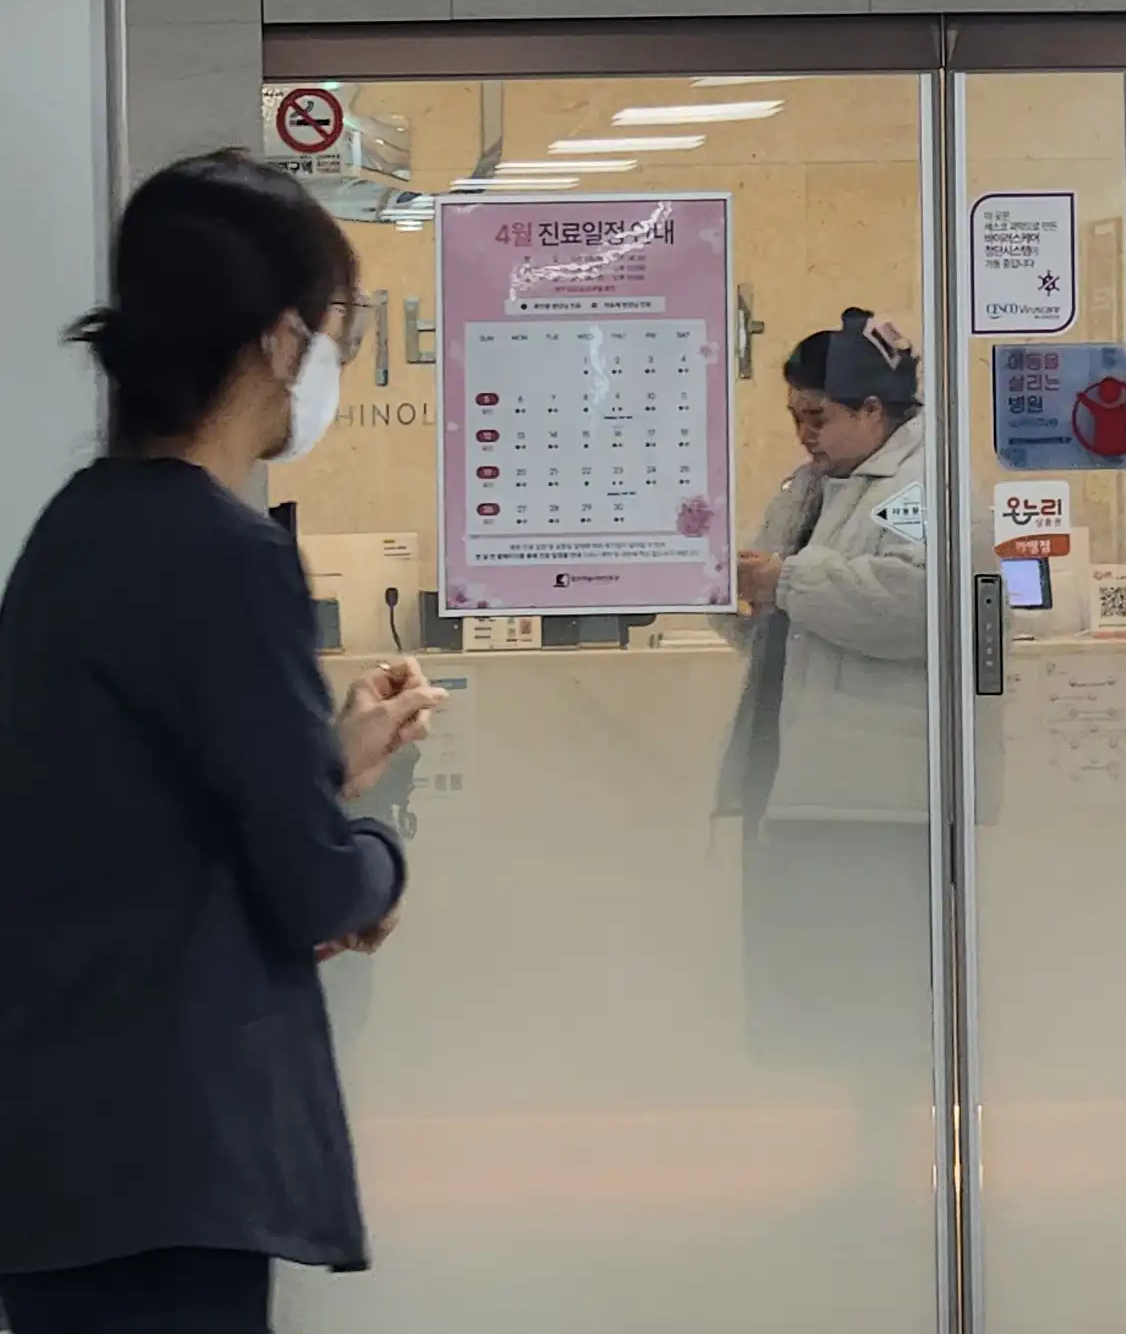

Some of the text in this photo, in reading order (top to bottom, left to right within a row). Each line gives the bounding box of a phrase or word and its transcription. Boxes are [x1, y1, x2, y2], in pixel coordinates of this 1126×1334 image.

[495, 222, 532, 247] 4월
[538, 221, 625, 246] 진료일정
[1008, 395, 1044, 414] 병원
